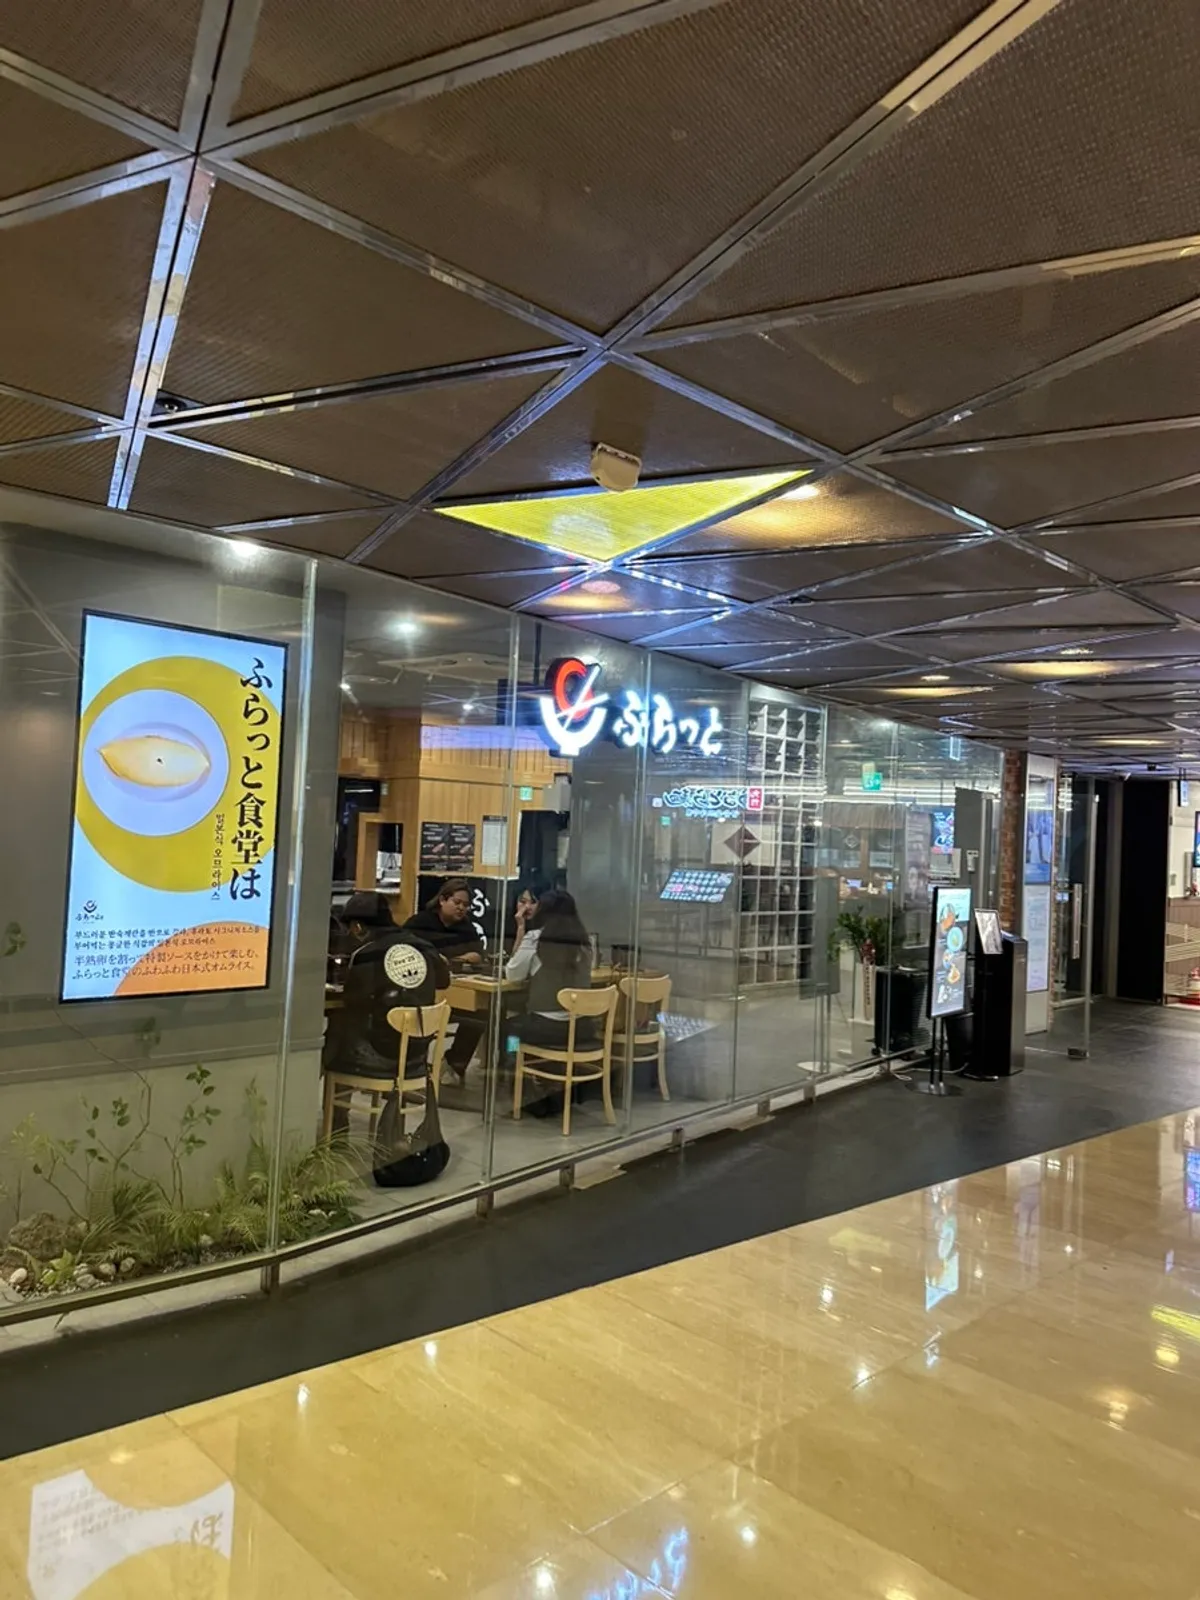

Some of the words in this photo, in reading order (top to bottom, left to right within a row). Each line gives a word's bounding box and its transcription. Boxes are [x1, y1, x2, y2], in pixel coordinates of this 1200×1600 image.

[613, 690, 724, 756] ふらっと
[229, 657, 273, 901] ふらっと食堂は
[214, 813, 225, 845] 일본식
[211, 848, 223, 900] 오므라이스
